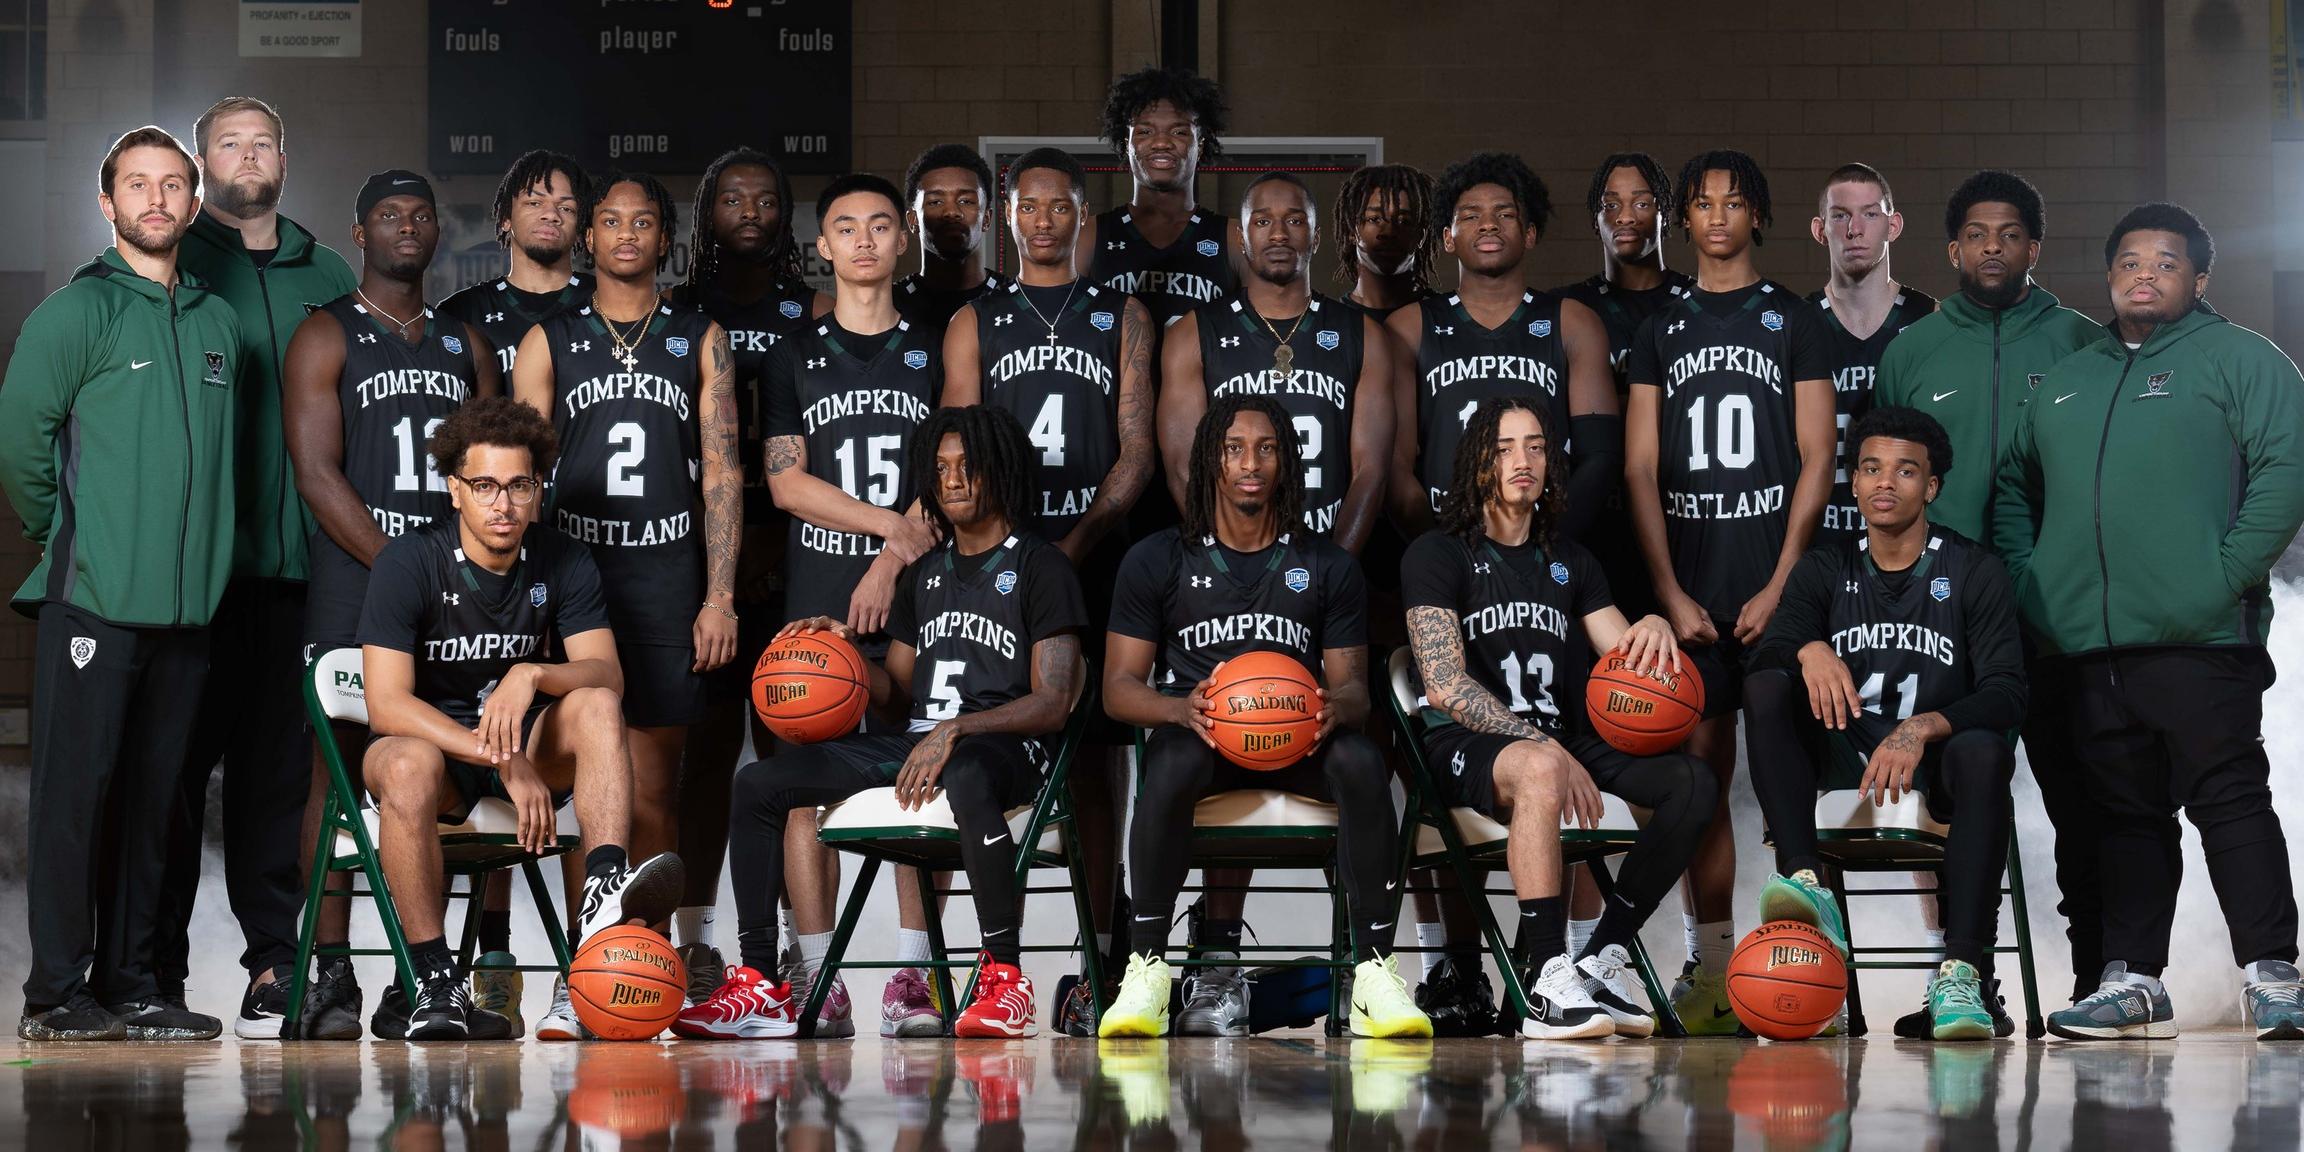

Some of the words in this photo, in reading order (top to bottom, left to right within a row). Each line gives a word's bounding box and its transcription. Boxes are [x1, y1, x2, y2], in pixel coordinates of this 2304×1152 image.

[249, 11, 298, 20] PROFANITY
[308, 11, 351, 20] EJECTION
[260, 36, 272, 46] BE
[274, 36, 281, 45] A
[282, 36, 309, 46] GOOD
[310, 36, 341, 46] SPORT
[445, 28, 501, 51] fouls
[600, 25, 678, 54] player
[779, 28, 834, 51] fouls
[450, 135, 493, 153] won
[609, 134, 669, 158] game
[784, 135, 827, 153] won
[990, 346, 1112, 395] TOMPKINS
[1426, 355, 1558, 397] TOMPKINS
[565, 373, 690, 421] TOMPKINS
[1214, 369, 1346, 410] TOMPKINS
[1027, 393, 1065, 467] 4
[1687, 394, 1755, 472] 10
[607, 422, 645, 497] 2
[835, 435, 902, 507] 15
[557, 507, 690, 547] CORTLAND
[801, 522, 887, 555] CORTL
[424, 633, 543, 661] TOMPKIN
[1178, 613, 1312, 653] TOMPKINS
[1832, 622, 1954, 666] TOMPKINS
[758, 649, 829, 672] SPALDING
[765, 683, 808, 708] NJCAA
[926, 660, 967, 720] 5
[1500, 650, 1560, 716] 13
[1228, 695, 1308, 715] SPALDING
[1606, 691, 1654, 715] NJCAA
[1243, 732, 1292, 752] NJCAA
[602, 948, 677, 978] SPALDING
[1770, 945, 1821, 967] NJCAA
[609, 982, 662, 1006] NJCAA
[2117, 997, 2144, 1018] N
